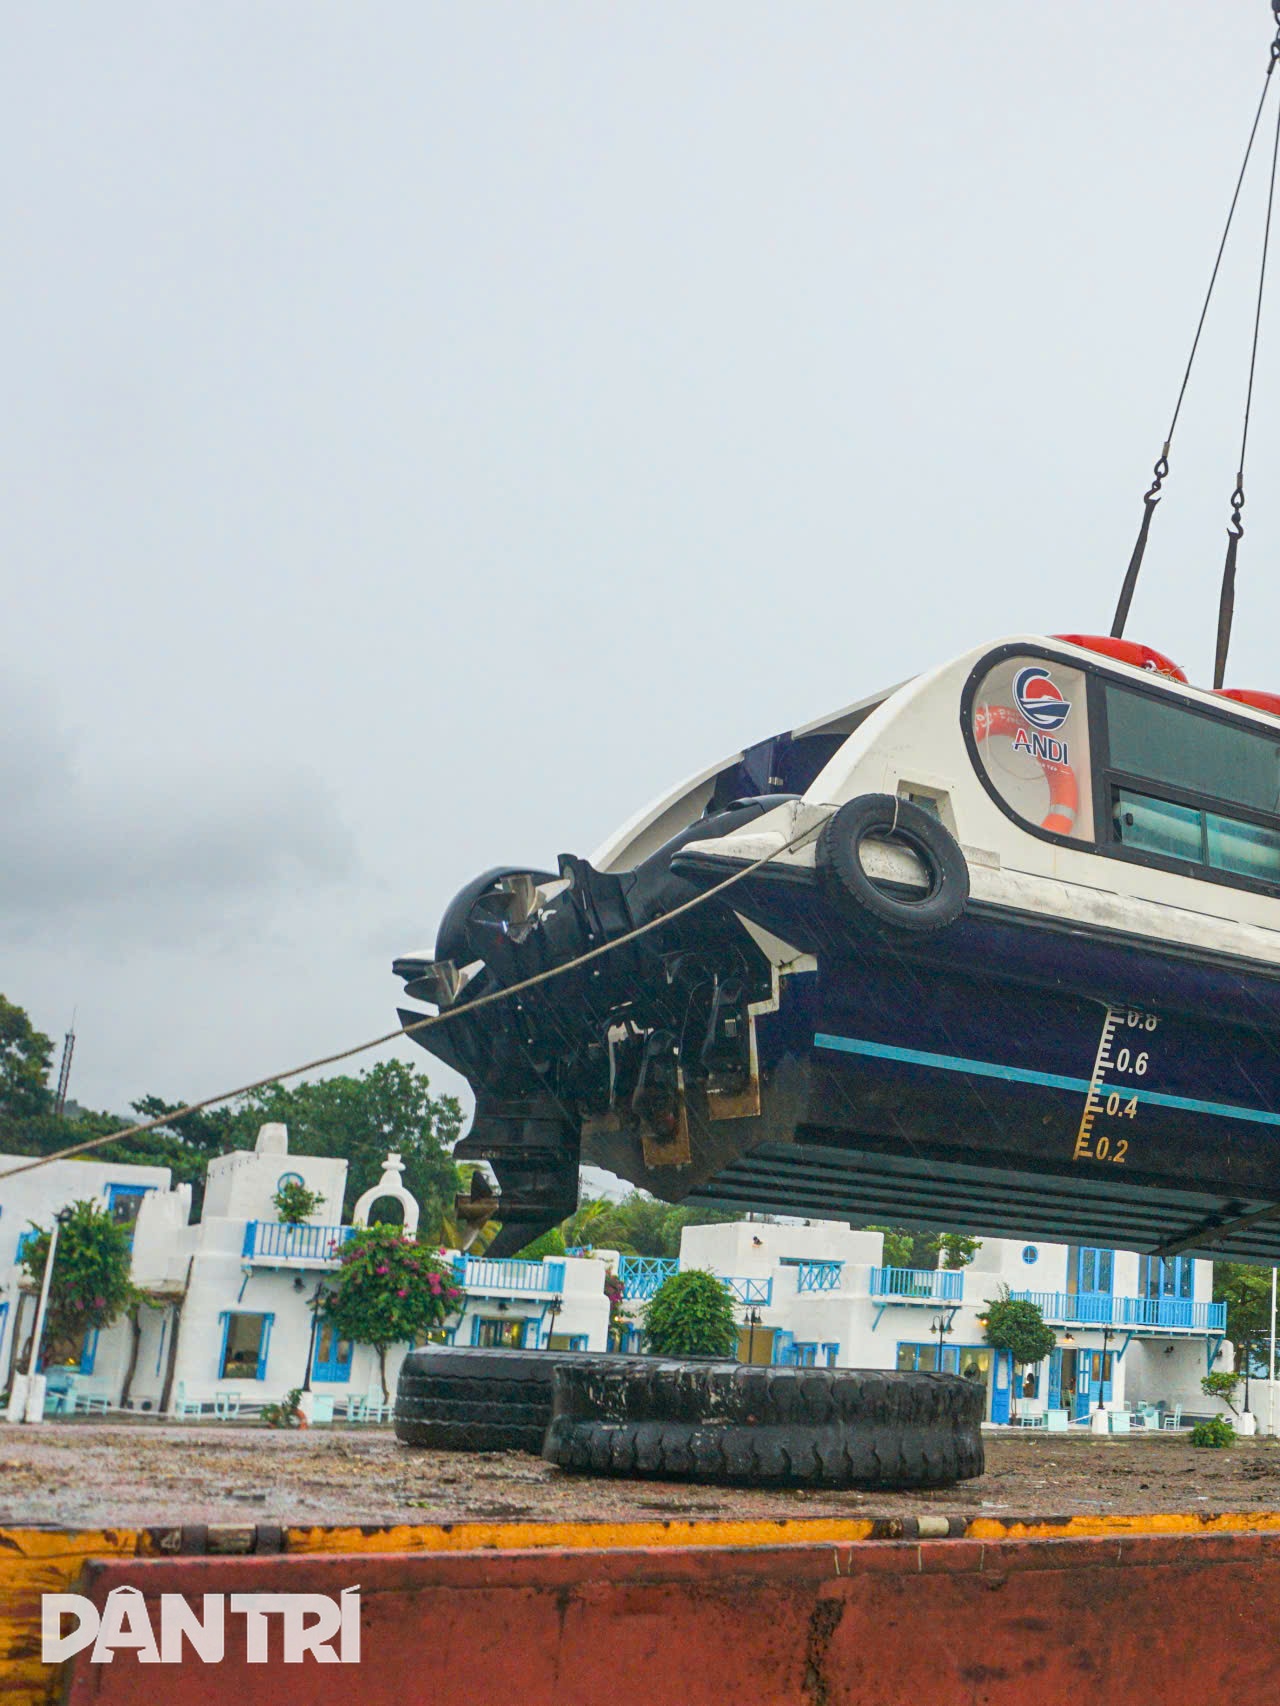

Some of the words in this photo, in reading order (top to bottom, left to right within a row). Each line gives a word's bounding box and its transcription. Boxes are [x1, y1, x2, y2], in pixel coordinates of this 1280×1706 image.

[1013, 729, 1069, 766] ANDI
[1116, 1048, 1149, 1076] 0.6
[1106, 1092, 1138, 1119] 0.4
[1095, 1136, 1129, 1163] 0.2
